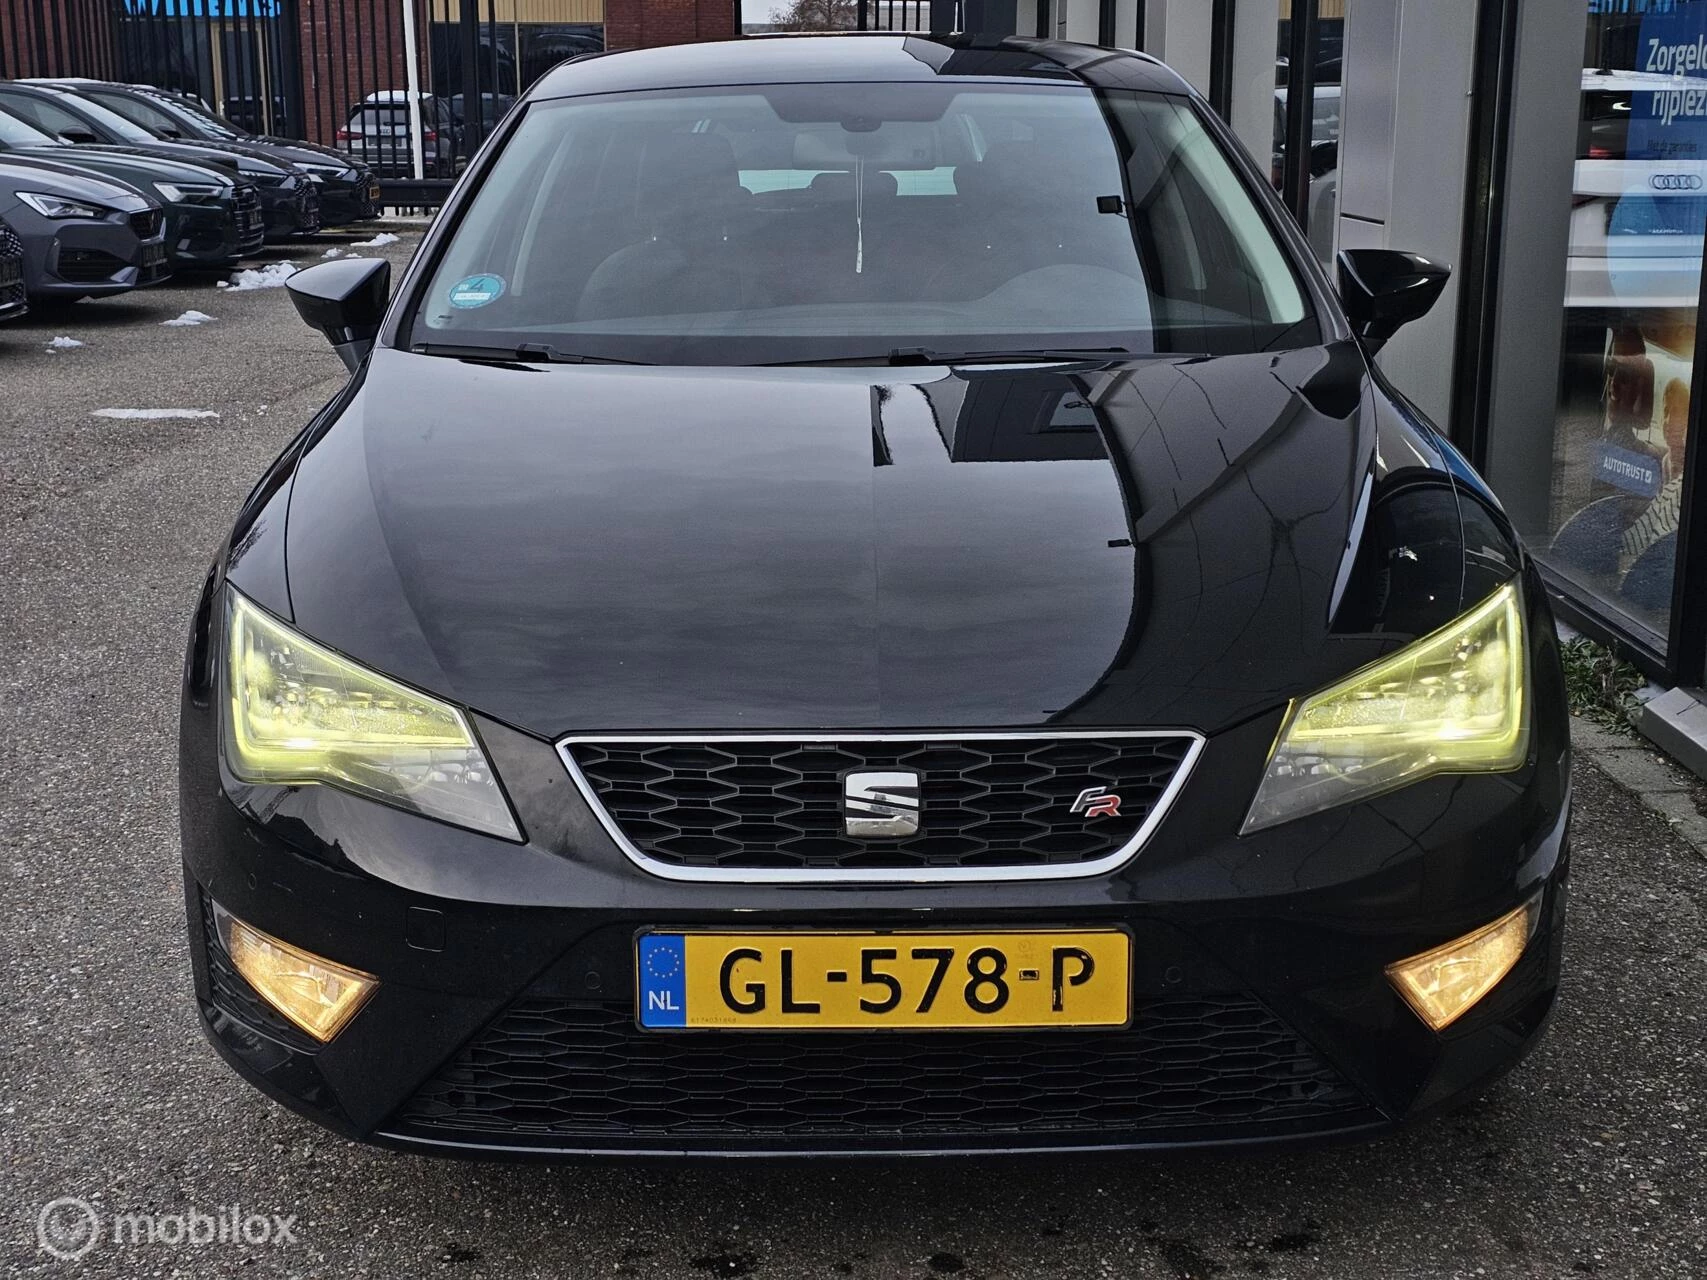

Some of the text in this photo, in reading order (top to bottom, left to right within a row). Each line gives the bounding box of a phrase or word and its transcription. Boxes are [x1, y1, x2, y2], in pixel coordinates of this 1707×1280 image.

[1652, 82, 1707, 126] rijplez
[1603, 456, 1645, 480] AUTOTRUST
[1069, 786, 1121, 817] FR
[718, 947, 1095, 1014] GL-578-P
[648, 991, 679, 1010] NL
